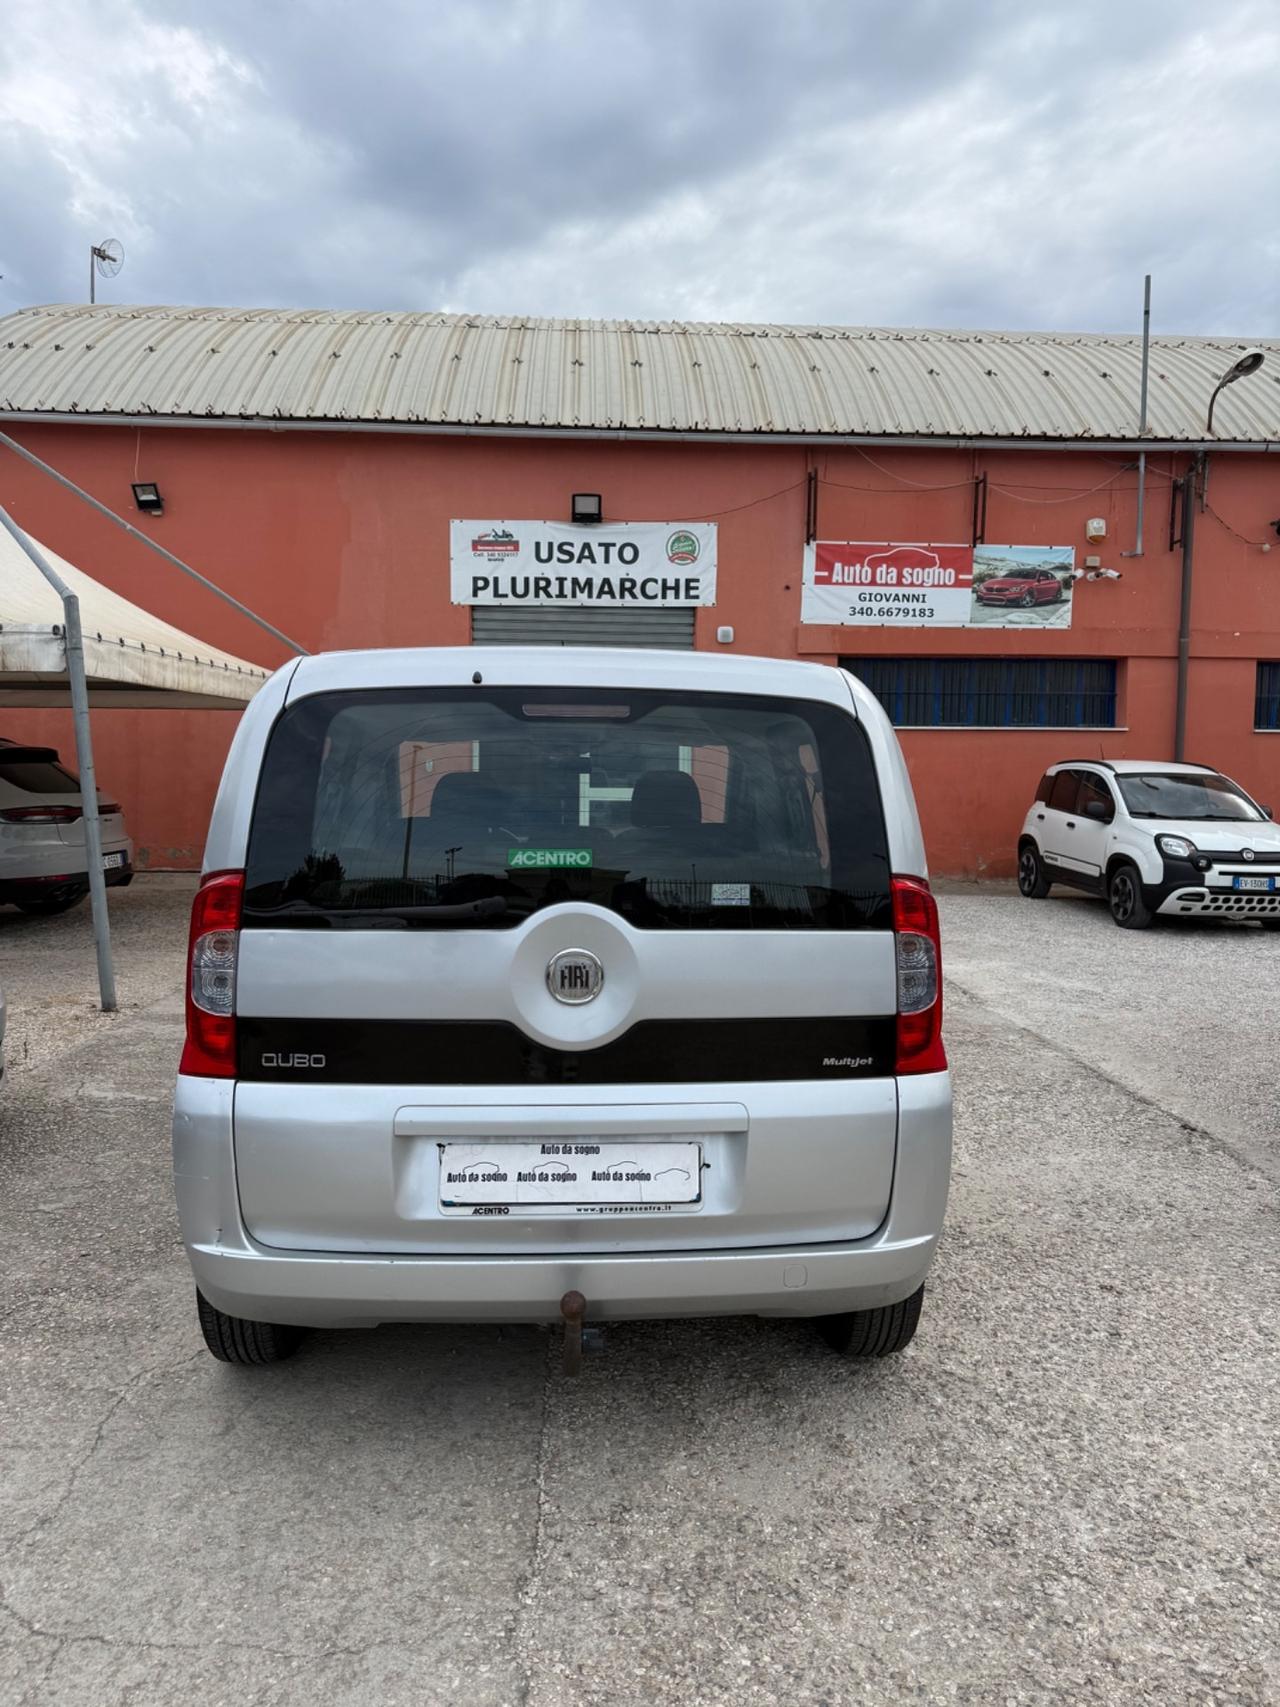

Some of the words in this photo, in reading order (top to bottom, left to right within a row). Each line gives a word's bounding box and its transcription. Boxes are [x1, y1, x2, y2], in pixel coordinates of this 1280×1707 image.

[534, 541, 640, 565] USATO
[832, 562, 872, 584] Auto
[874, 563, 897, 584] da
[902, 566, 956, 587] sogno
[471, 576, 701, 600] PLURIMARCHE
[858, 592, 927, 603] GIOVANNI
[848, 606, 935, 619] 340.6679183
[511, 851, 591, 866] ACENTRO
[559, 964, 590, 991] FIAT
[262, 1053, 326, 1067] QUBO
[540, 1144, 560, 1155] Auto
[562, 1144, 573, 1155] da
[574, 1145, 601, 1156] sogno
[447, 1172, 467, 1183] Auto
[468, 1172, 479, 1182] da
[517, 1171, 537, 1182] Auto
[538, 1172, 549, 1182] da
[551, 1172, 577, 1183] sogno
[591, 1171, 611, 1181] Auto
[612, 1171, 623, 1181] da
[472, 1207, 510, 1215] ACENTRO
